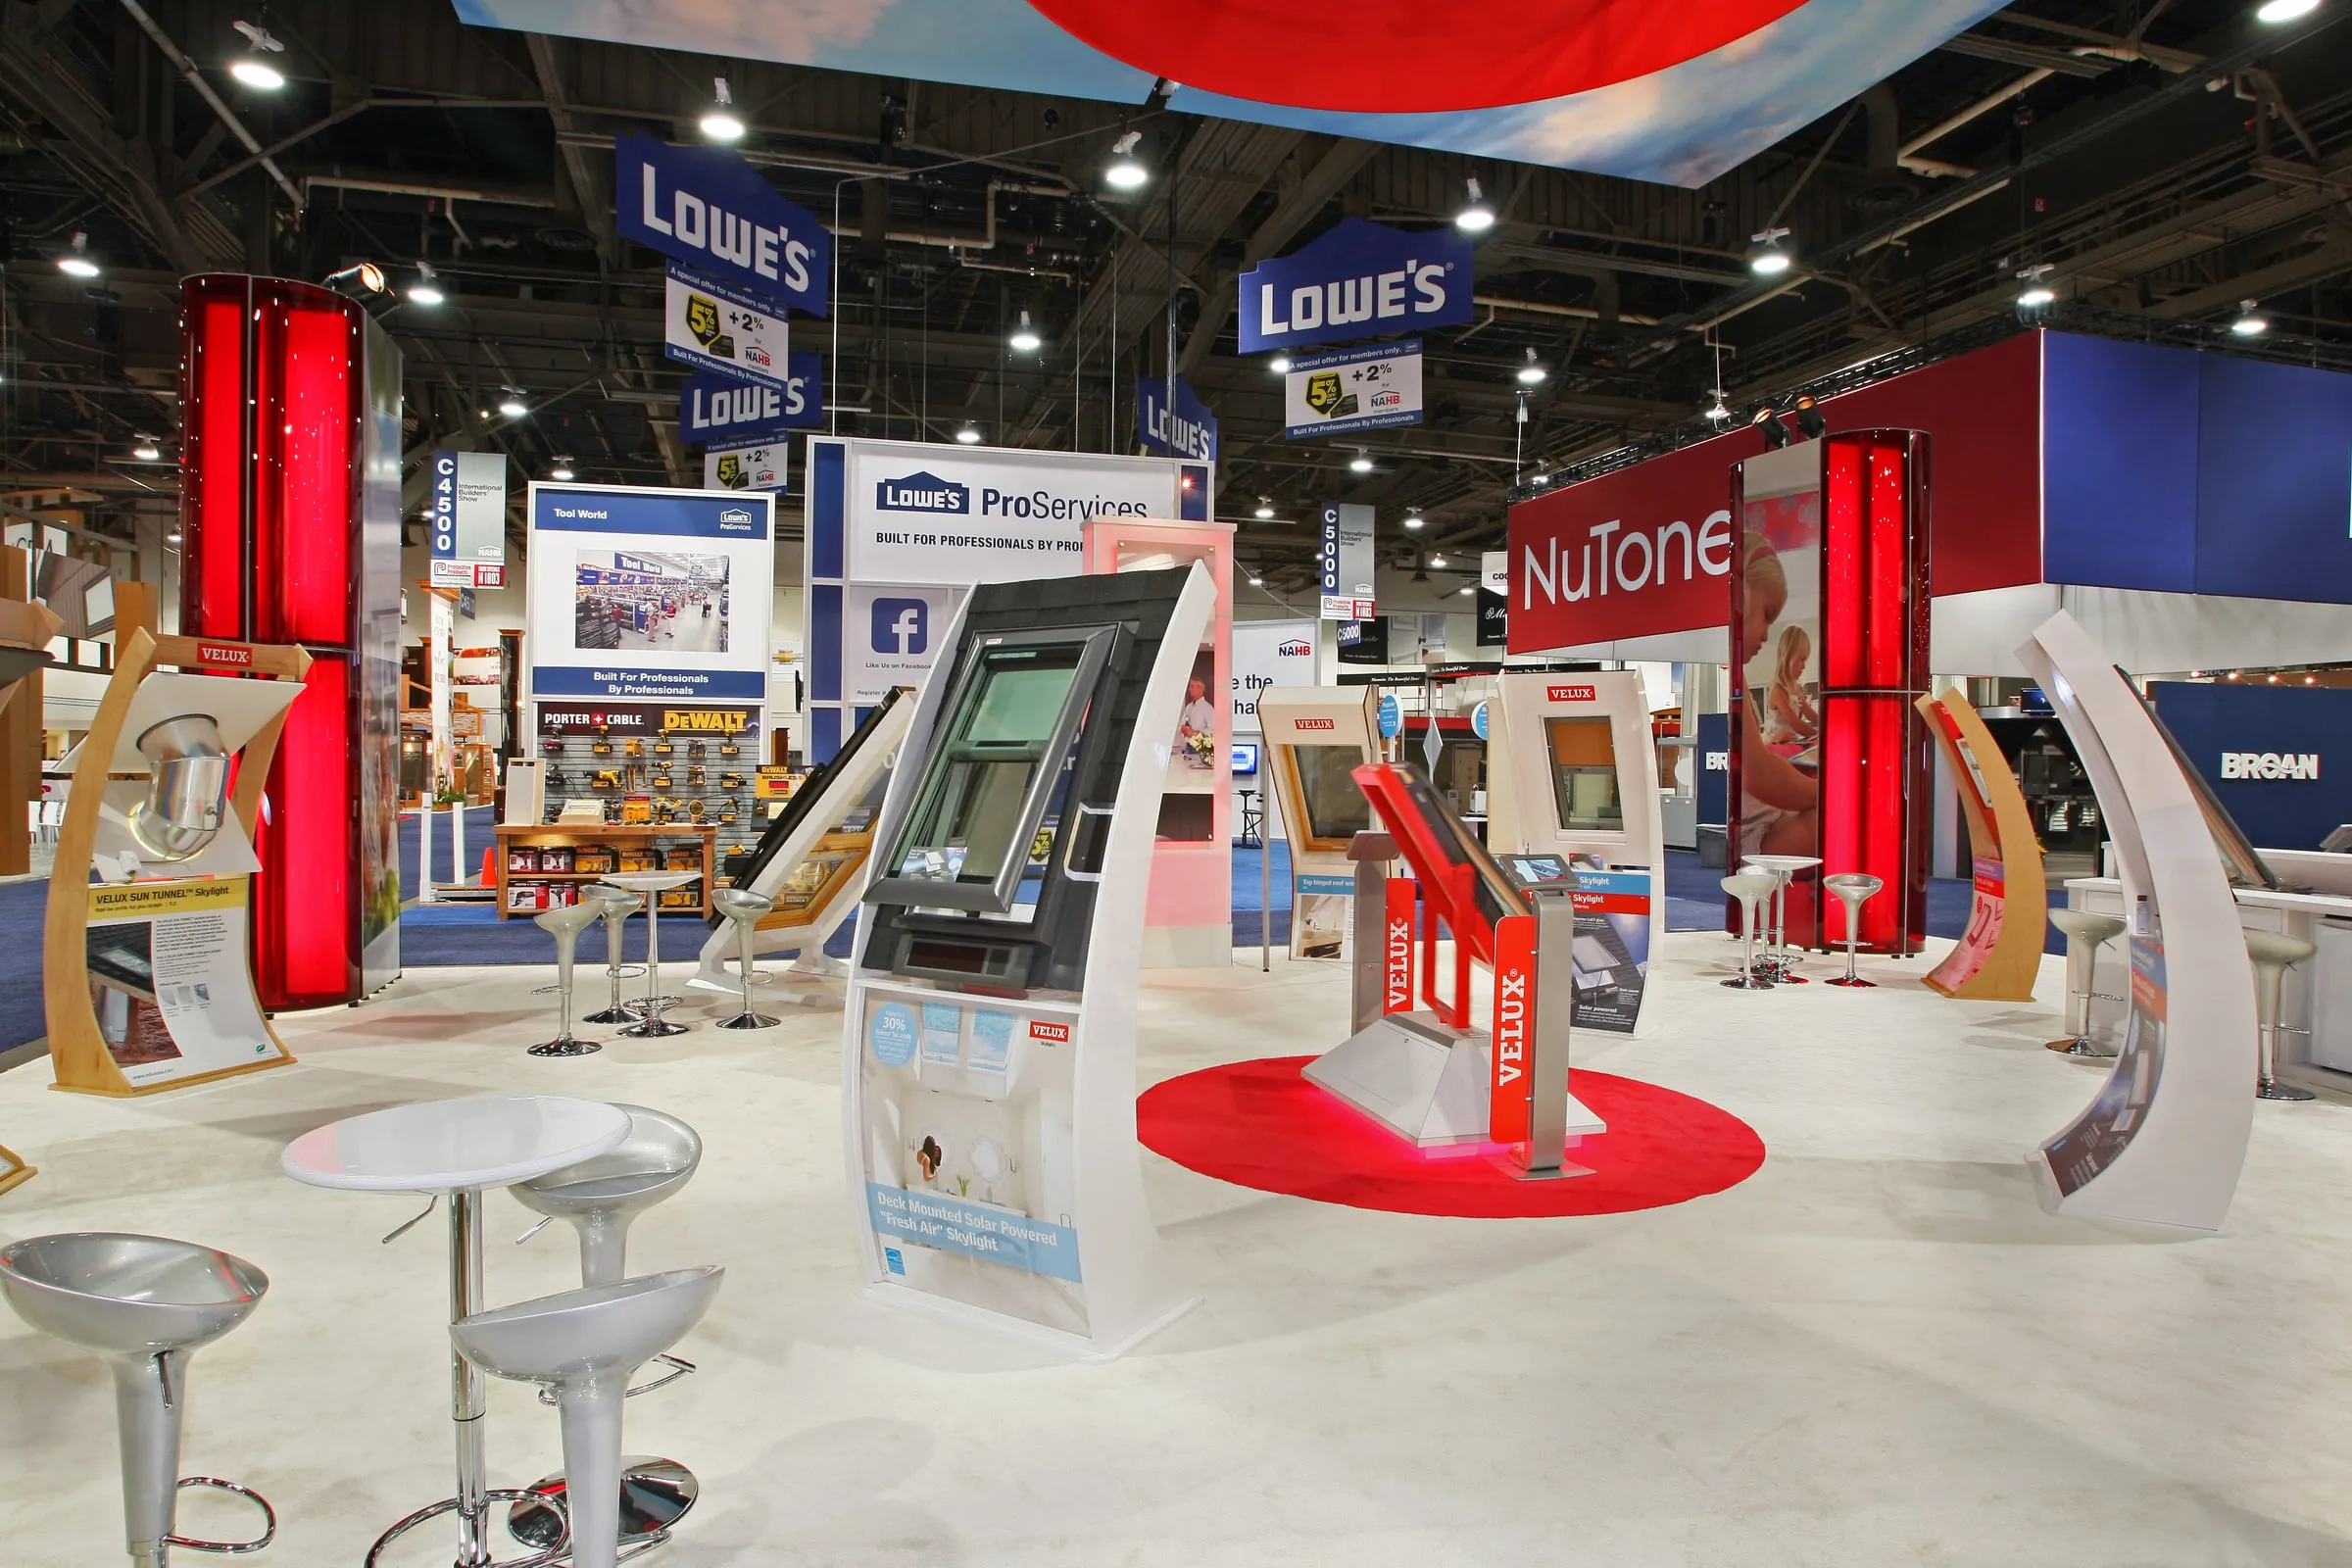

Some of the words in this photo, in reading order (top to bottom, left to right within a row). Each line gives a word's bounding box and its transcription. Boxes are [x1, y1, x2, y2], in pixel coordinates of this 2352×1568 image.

[643, 163, 809, 292] LOWE'S
[670, 267, 676, 275] A
[677, 270, 700, 285] special
[701, 279, 716, 292] offer
[717, 286, 727, 296] for
[727, 290, 757, 307] members
[1262, 259, 1446, 336] LOWE'S
[742, 314, 764, 332] 2%
[745, 349, 771, 367] NAHB
[1296, 358, 1321, 370] special
[1322, 354, 1337, 364] offer
[1350, 349, 1383, 360] members
[673, 348, 686, 361] Built
[688, 354, 699, 364] For
[699, 357, 737, 375] Professionals
[737, 369, 745, 379] By
[745, 372, 782, 391] Professionals
[1367, 363, 1392, 381] 2%
[1371, 395, 1400, 407] NAHB
[1293, 427, 1308, 436] Built
[1320, 421, 1361, 432] Professionals
[1372, 414, 1414, 425] Professionals
[756, 473, 774, 483] NAHB
[458, 483, 502, 491] International
[887, 486, 960, 509] LOWE'S
[982, 488, 1148, 520] ProServices
[555, 508, 576, 518] Tool
[578, 509, 607, 519] World
[720, 522, 751, 531] ProServices
[877, 533, 910, 544] BUILT
[914, 534, 936, 545] FOR
[940, 536, 1034, 550] PROFESSIONALS
[1038, 540, 1052, 550] BY
[621, 557, 640, 570] Tool
[1524, 510, 1731, 611] NuTone
[1338, 625, 1359, 641] C5000
[201, 646, 248, 663] VELUX
[1278, 646, 1311, 656] NAHB
[593, 671, 617, 682] Built
[620, 672, 637, 682] For
[640, 673, 709, 684] Professionals
[1245, 674, 1274, 690] the
[609, 684, 623, 695] By
[624, 685, 694, 695] Professionals
[1551, 688, 1591, 698] VELUX
[545, 713, 590, 724] PORTER
[1297, 720, 1331, 728] VELUX
[2221, 753, 2318, 780] BROAN
[1580, 876, 1609, 886] Skylight
[97, 893, 128, 904] VELUX
[130, 892, 150, 902] SUN
[196, 886, 229, 898] Skylight
[1573, 894, 1604, 904] Skylight
[1389, 922, 1409, 1007] VELUX
[883, 1017, 906, 1030] 30%
[1033, 1025, 1066, 1038] VELUX
[1499, 975, 1525, 1086] VELUX
[878, 1192, 906, 1211] Deck
[908, 1200, 961, 1223] Mounted
[964, 1213, 997, 1231] Solar
[1000, 1220, 1057, 1246] Powered
[947, 1228, 999, 1252] Skylight
